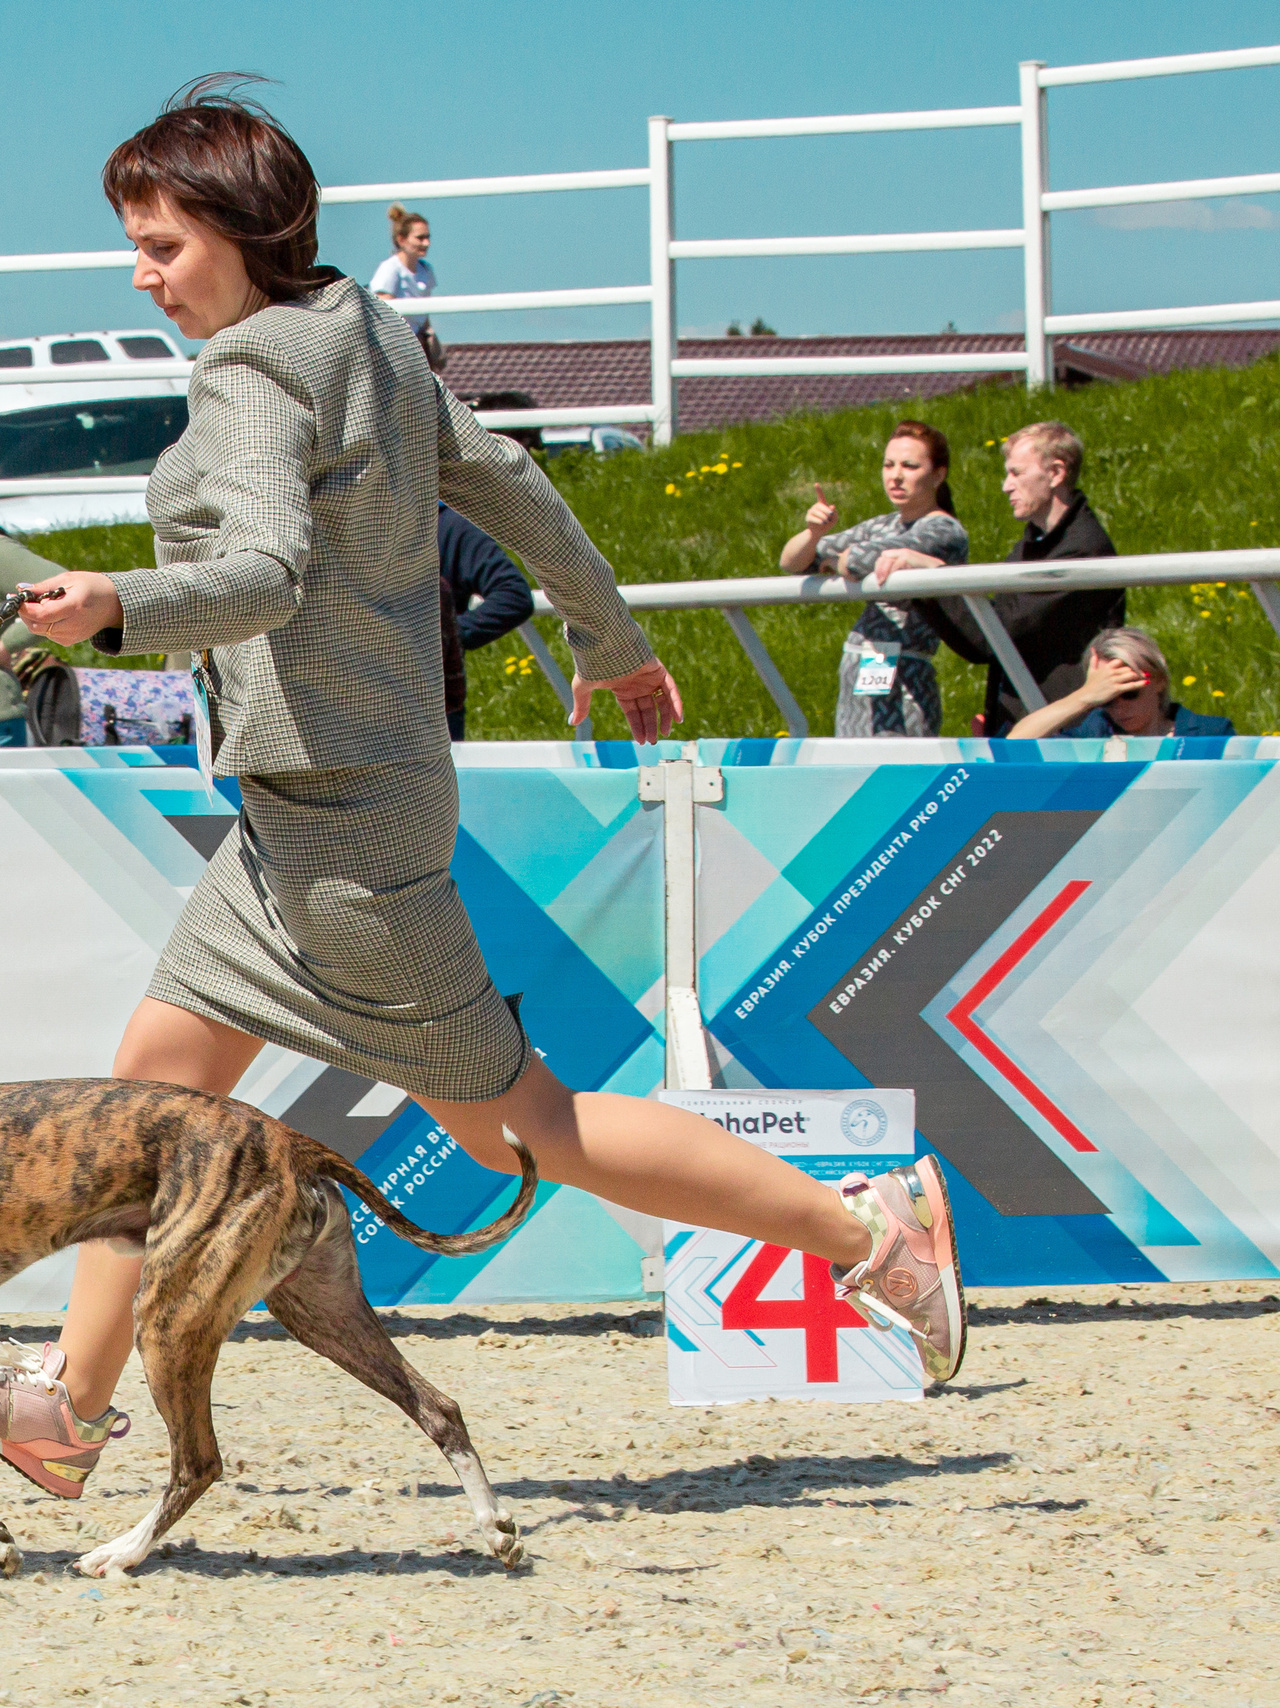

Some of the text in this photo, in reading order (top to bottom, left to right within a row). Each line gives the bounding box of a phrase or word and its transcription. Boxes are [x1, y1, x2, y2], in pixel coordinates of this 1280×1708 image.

[735, 768, 970, 1019] ЕВРАЗИЯ. КУБОК ПРЕЗИДЕНТА РКФ 2022
[829, 829, 1003, 1014] ЕВРАЗИЯ. КУБОК СНГ 2022
[404, 1135, 459, 1195] РОССИЙ
[699, 1111, 807, 1134] haPet
[722, 1242, 869, 1383] 4
